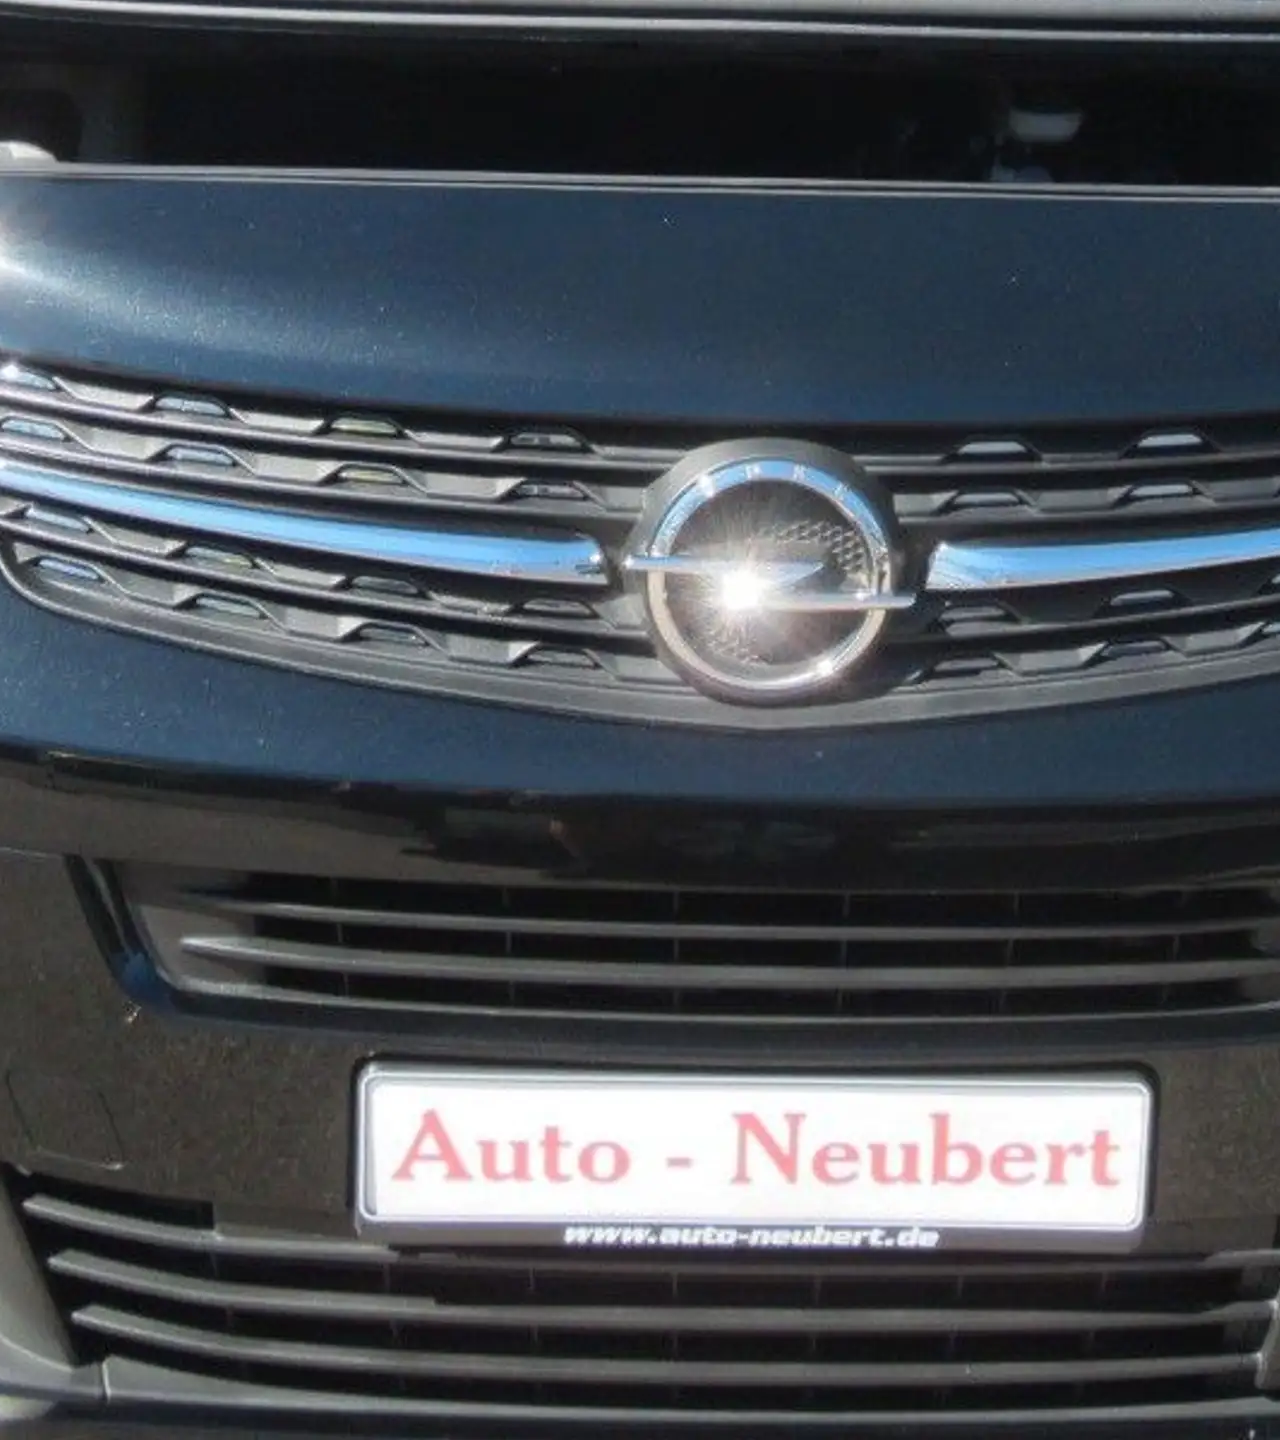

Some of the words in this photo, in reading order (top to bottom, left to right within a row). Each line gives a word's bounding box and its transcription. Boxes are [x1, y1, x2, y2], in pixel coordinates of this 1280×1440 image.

[392, 1109, 632, 1184] Auto
[666, 1156, 693, 1169] -
[729, 1111, 1121, 1187] Neubert
[563, 1225, 940, 1249] www.auto-neubert.de
